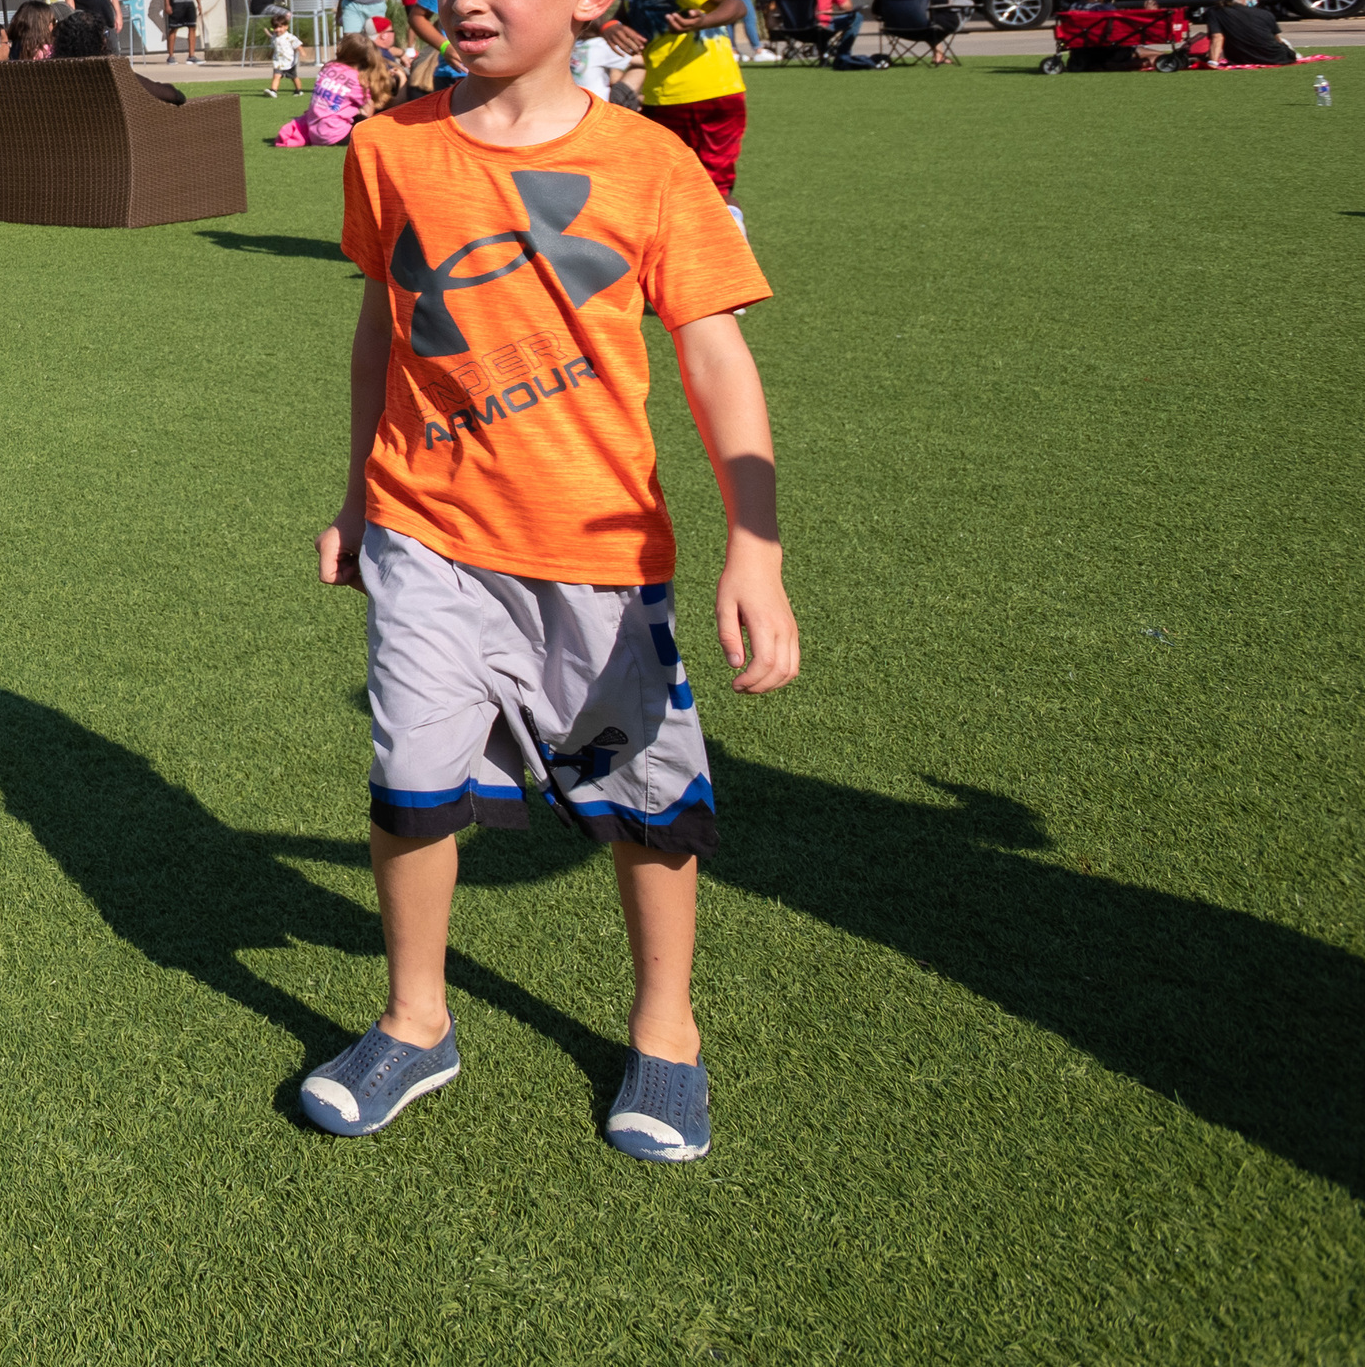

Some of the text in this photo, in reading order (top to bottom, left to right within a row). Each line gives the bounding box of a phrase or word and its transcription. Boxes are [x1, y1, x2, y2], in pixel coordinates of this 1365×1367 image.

[314, 85, 345, 105] URE
[410, 330, 568, 422] UNDER
[425, 355, 599, 449] ARMOUR
